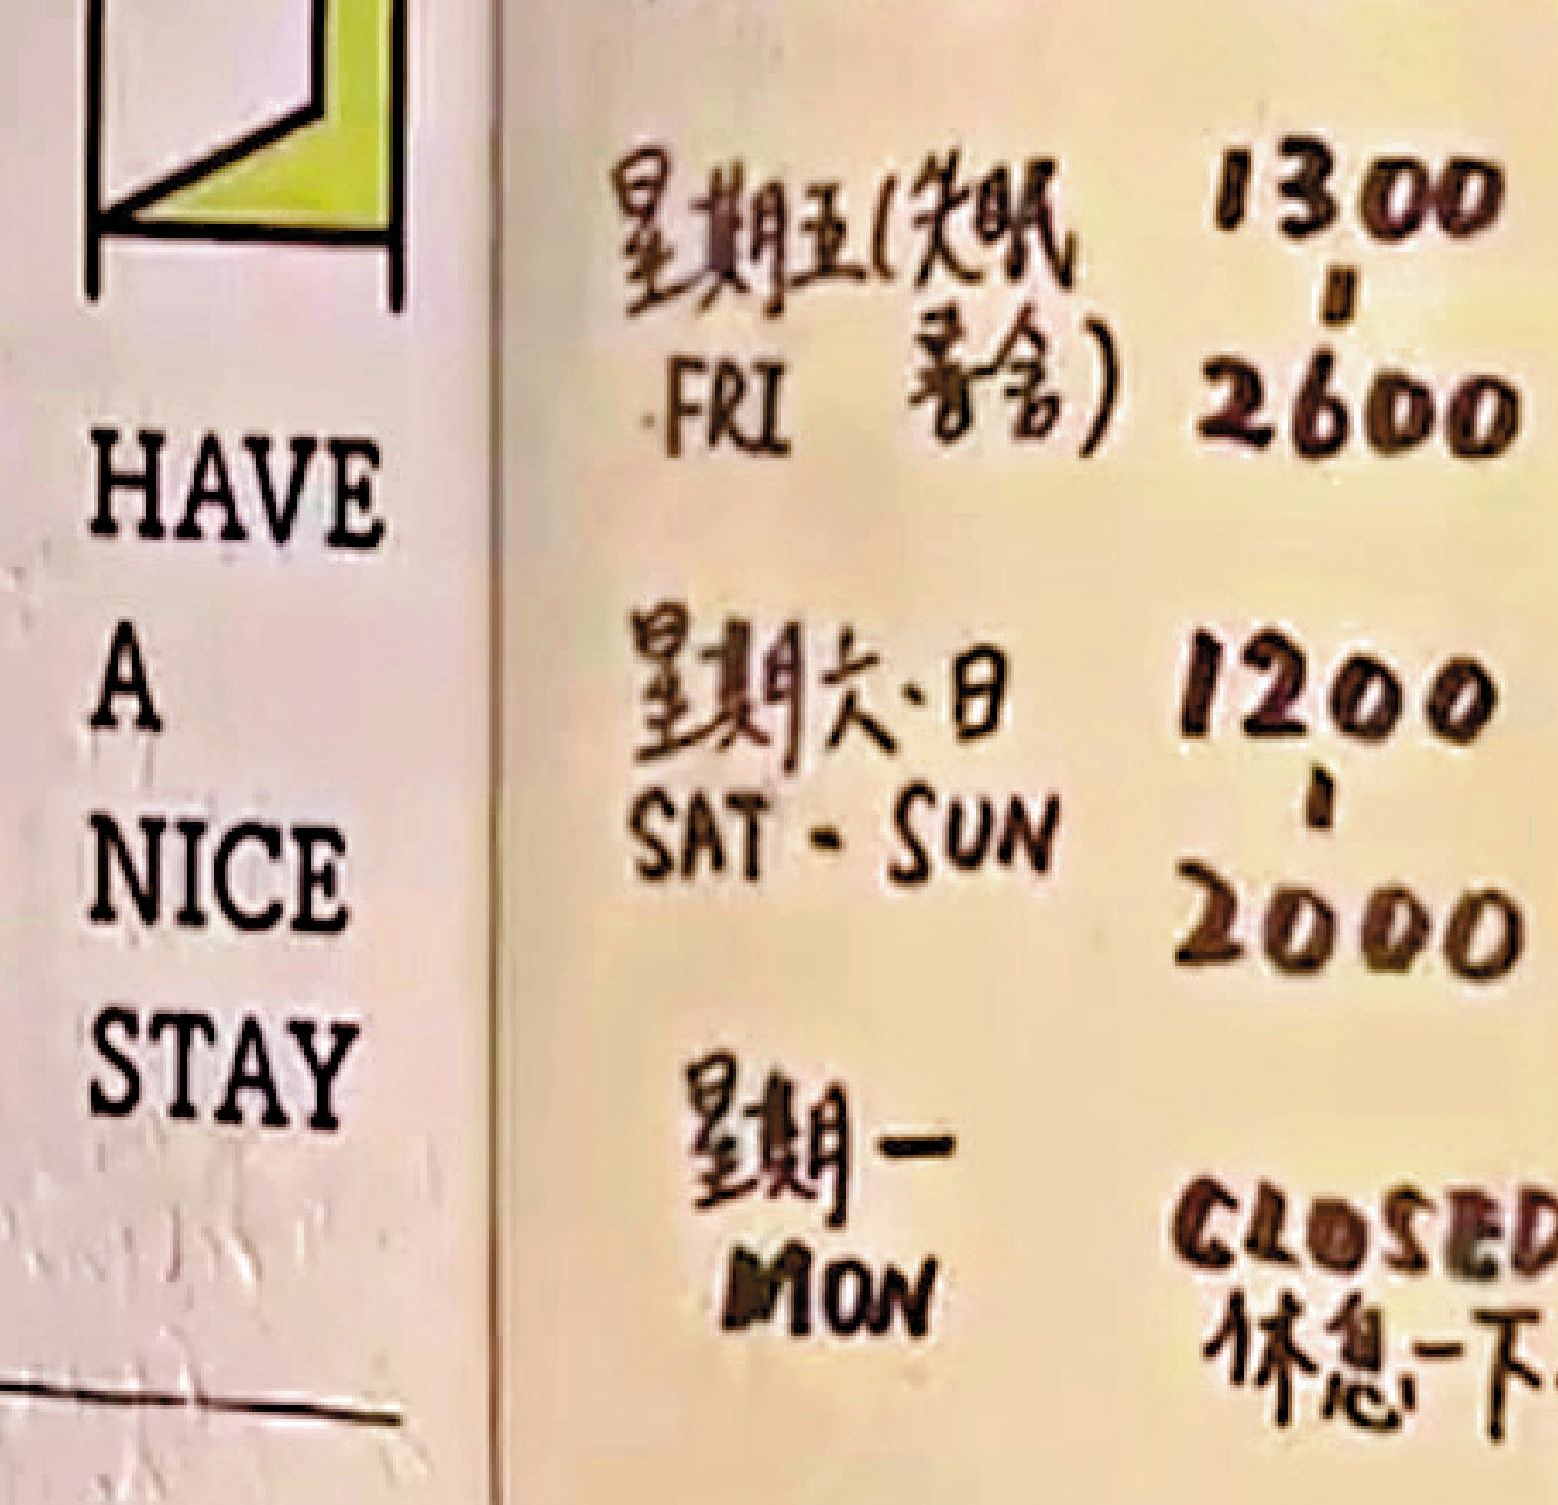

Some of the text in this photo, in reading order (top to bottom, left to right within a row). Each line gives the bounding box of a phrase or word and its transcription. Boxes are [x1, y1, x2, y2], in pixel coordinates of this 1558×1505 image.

[1216, 135, 1505, 241] 1300
[667, 355, 791, 458] FRI
[1199, 348, 1518, 461] 2600
[91, 430, 383, 550] HAVE
[91, 622, 163, 732] A
[1182, 629, 1498, 746] 1200
[91, 815, 348, 935] NICE
[630, 787, 770, 883] SAT
[890, 780, 1059, 887] SUN
[1175, 859, 1522, 983] 2000
[91, 1007, 359, 1130] STAY
[685, 1052, 956, 1230] 星期一
[1172, 1179, 1558, 1282] CLOSED
[722, 1240, 938, 1340] MON
[1203, 1281, 1542, 1443] 休息一下
